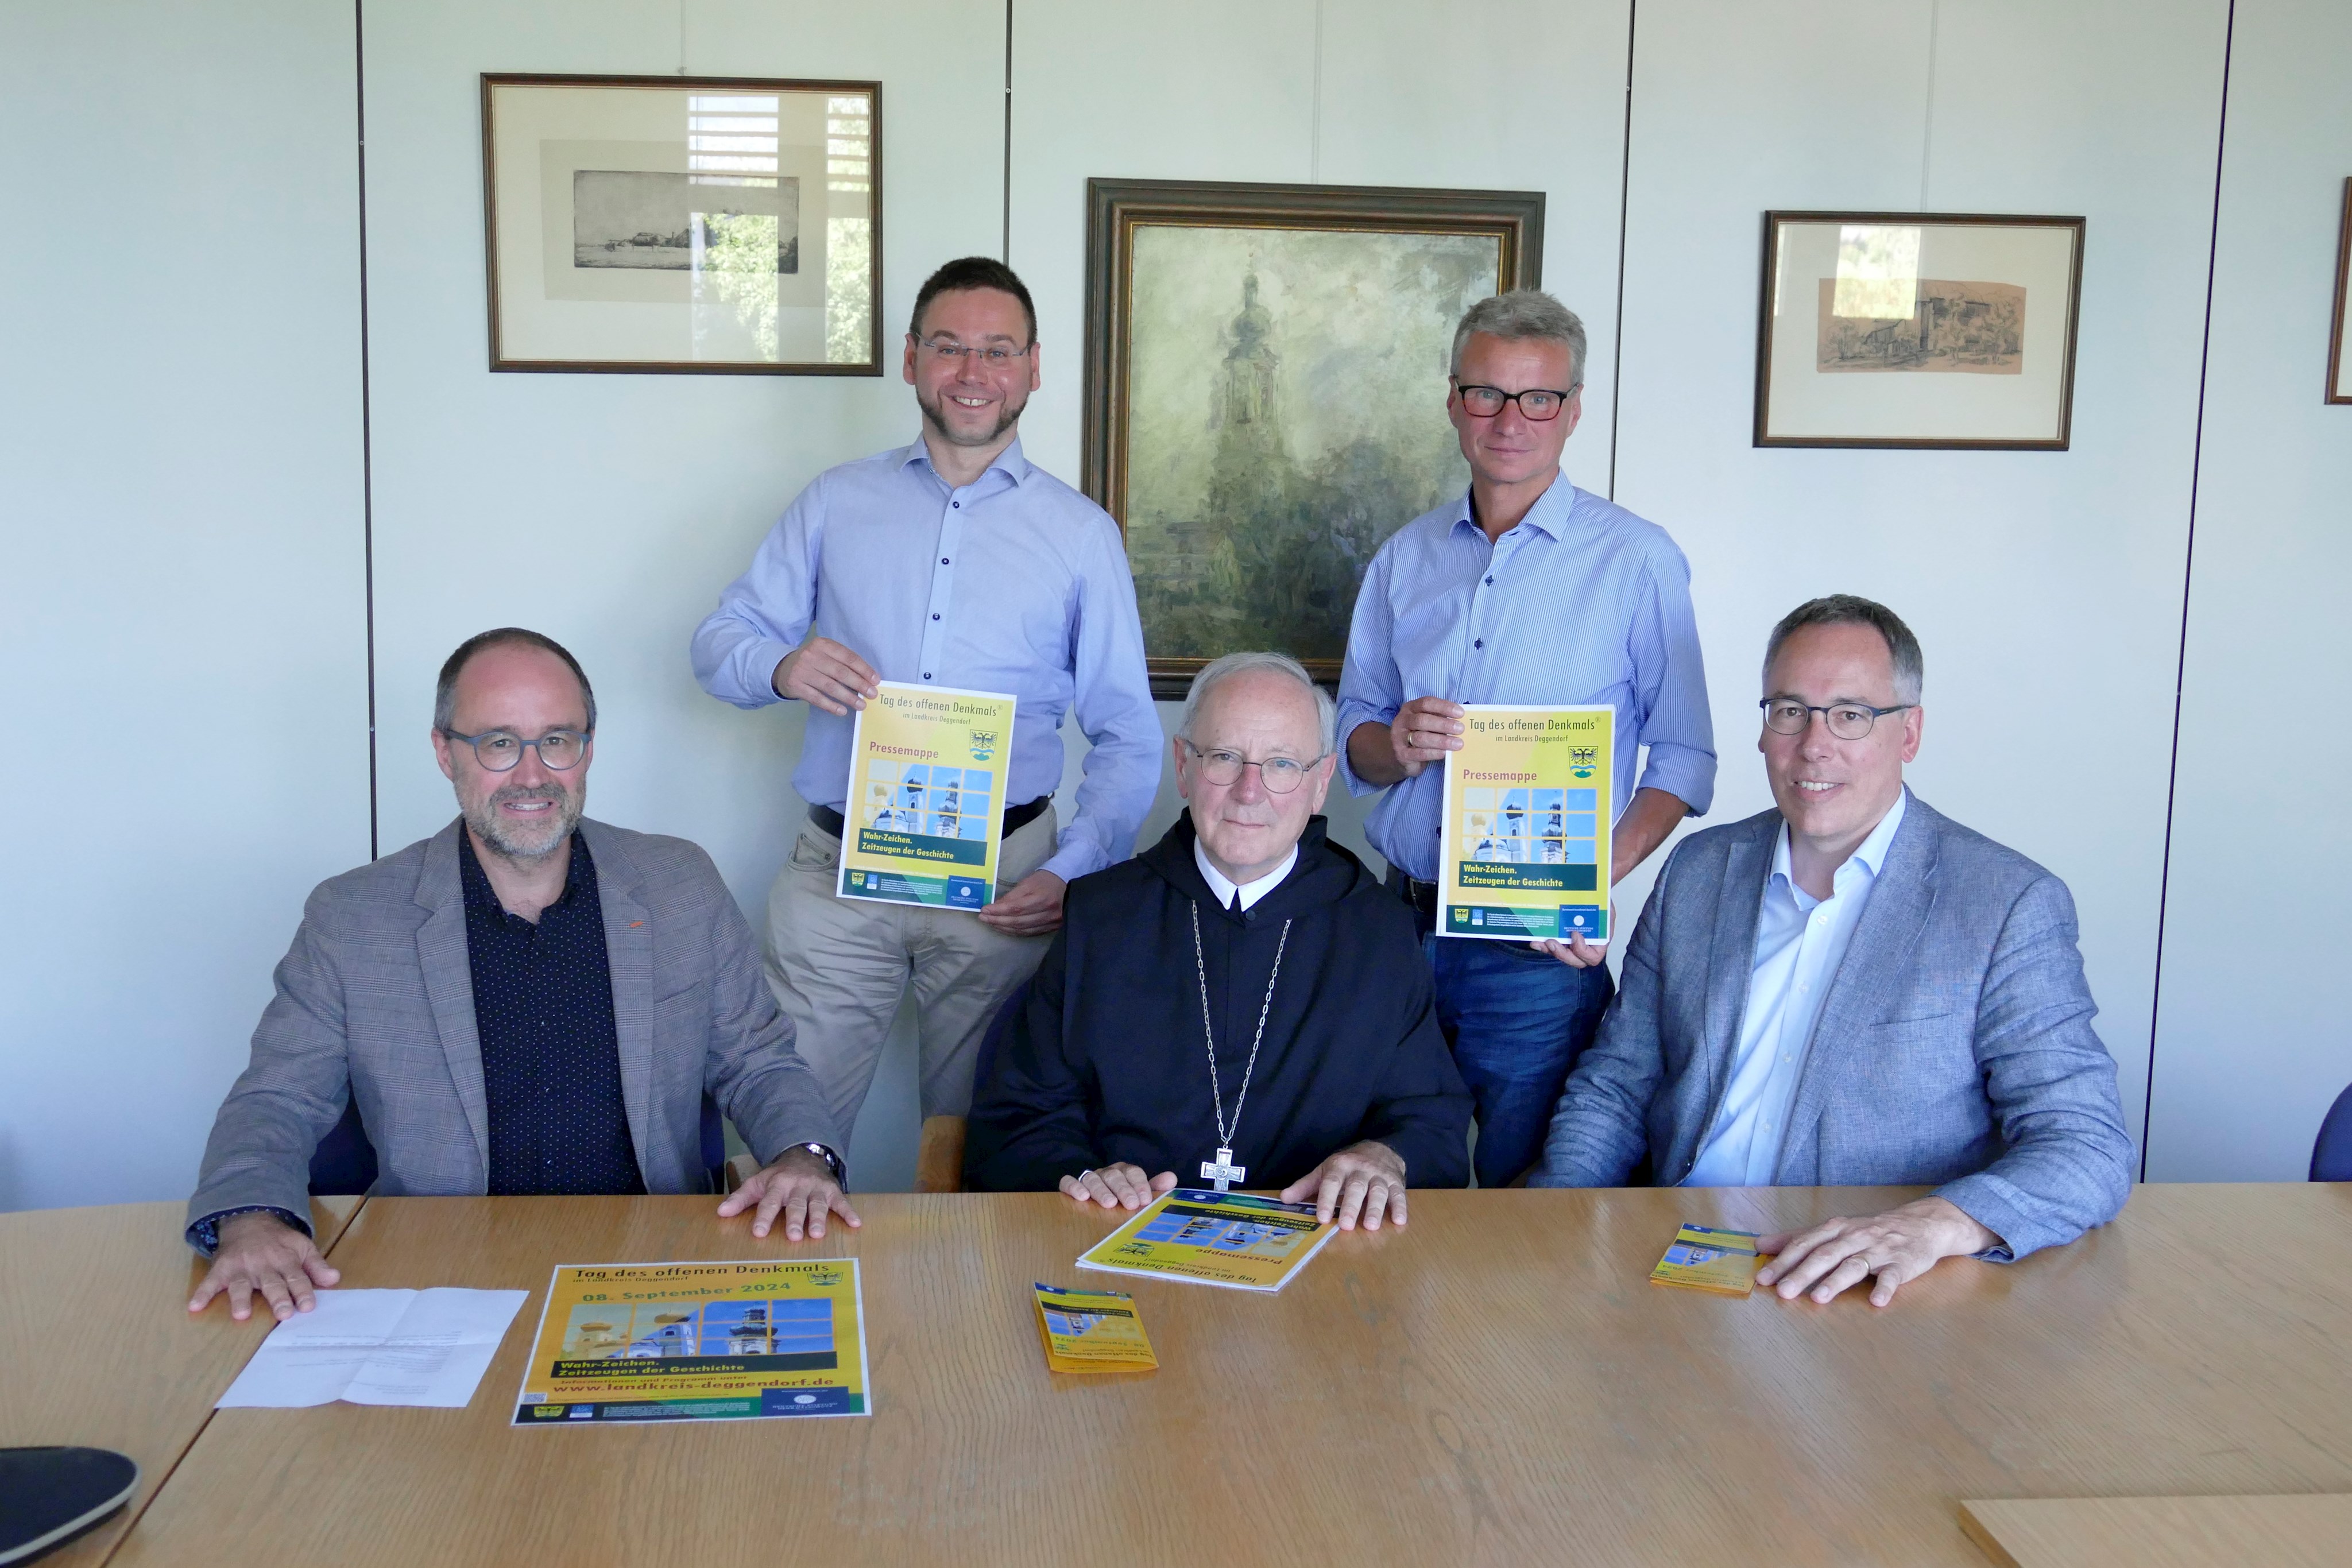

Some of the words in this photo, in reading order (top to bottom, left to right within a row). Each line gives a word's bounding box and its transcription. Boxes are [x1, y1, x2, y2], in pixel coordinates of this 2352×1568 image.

[880, 694, 894, 708] Tag
[897, 696, 912, 707] des
[916, 699, 950, 711] offenen
[911, 713, 938, 722] Landkreis
[939, 715, 970, 725] Deggendorf
[1469, 718, 1485, 732] Tag
[1489, 719, 1504, 730] des
[1508, 719, 1545, 730] offenen
[1534, 735, 1568, 743] Deggendorf
[869, 741, 939, 760] Pressemappe
[1463, 769, 1537, 783] Pressemappe
[863, 831, 912, 844] Wahr-Zeichen.
[862, 842, 901, 854] Zeitzeugen
[903, 847, 915, 855] der
[916, 848, 954, 860] Geschichte
[1464, 864, 1517, 874] Wahr-Zeichen.
[1464, 876, 1505, 886] Zeitzeugen
[1507, 877, 1520, 885] der
[1522, 878, 1563, 886] Geschichte
[1196, 1248, 1283, 1264] Pressemappe
[575, 1269, 606, 1279] Tag
[615, 1269, 647, 1277] des
[655, 1267, 728, 1276] offenen
[736, 1264, 829, 1273] Denkmals
[1167, 1265, 1211, 1276] offenen
[1238, 1275, 1257, 1283] Tag
[623, 1287, 732, 1300] September
[741, 1283, 791, 1292] 2024
[558, 1367, 637, 1376] Zeitzeugen
[670, 1364, 745, 1373] Geschichte
[561, 1360, 660, 1369] Wahr-Zeichen.
[554, 1378, 834, 1392] www.landkreis-deggendorf.de
